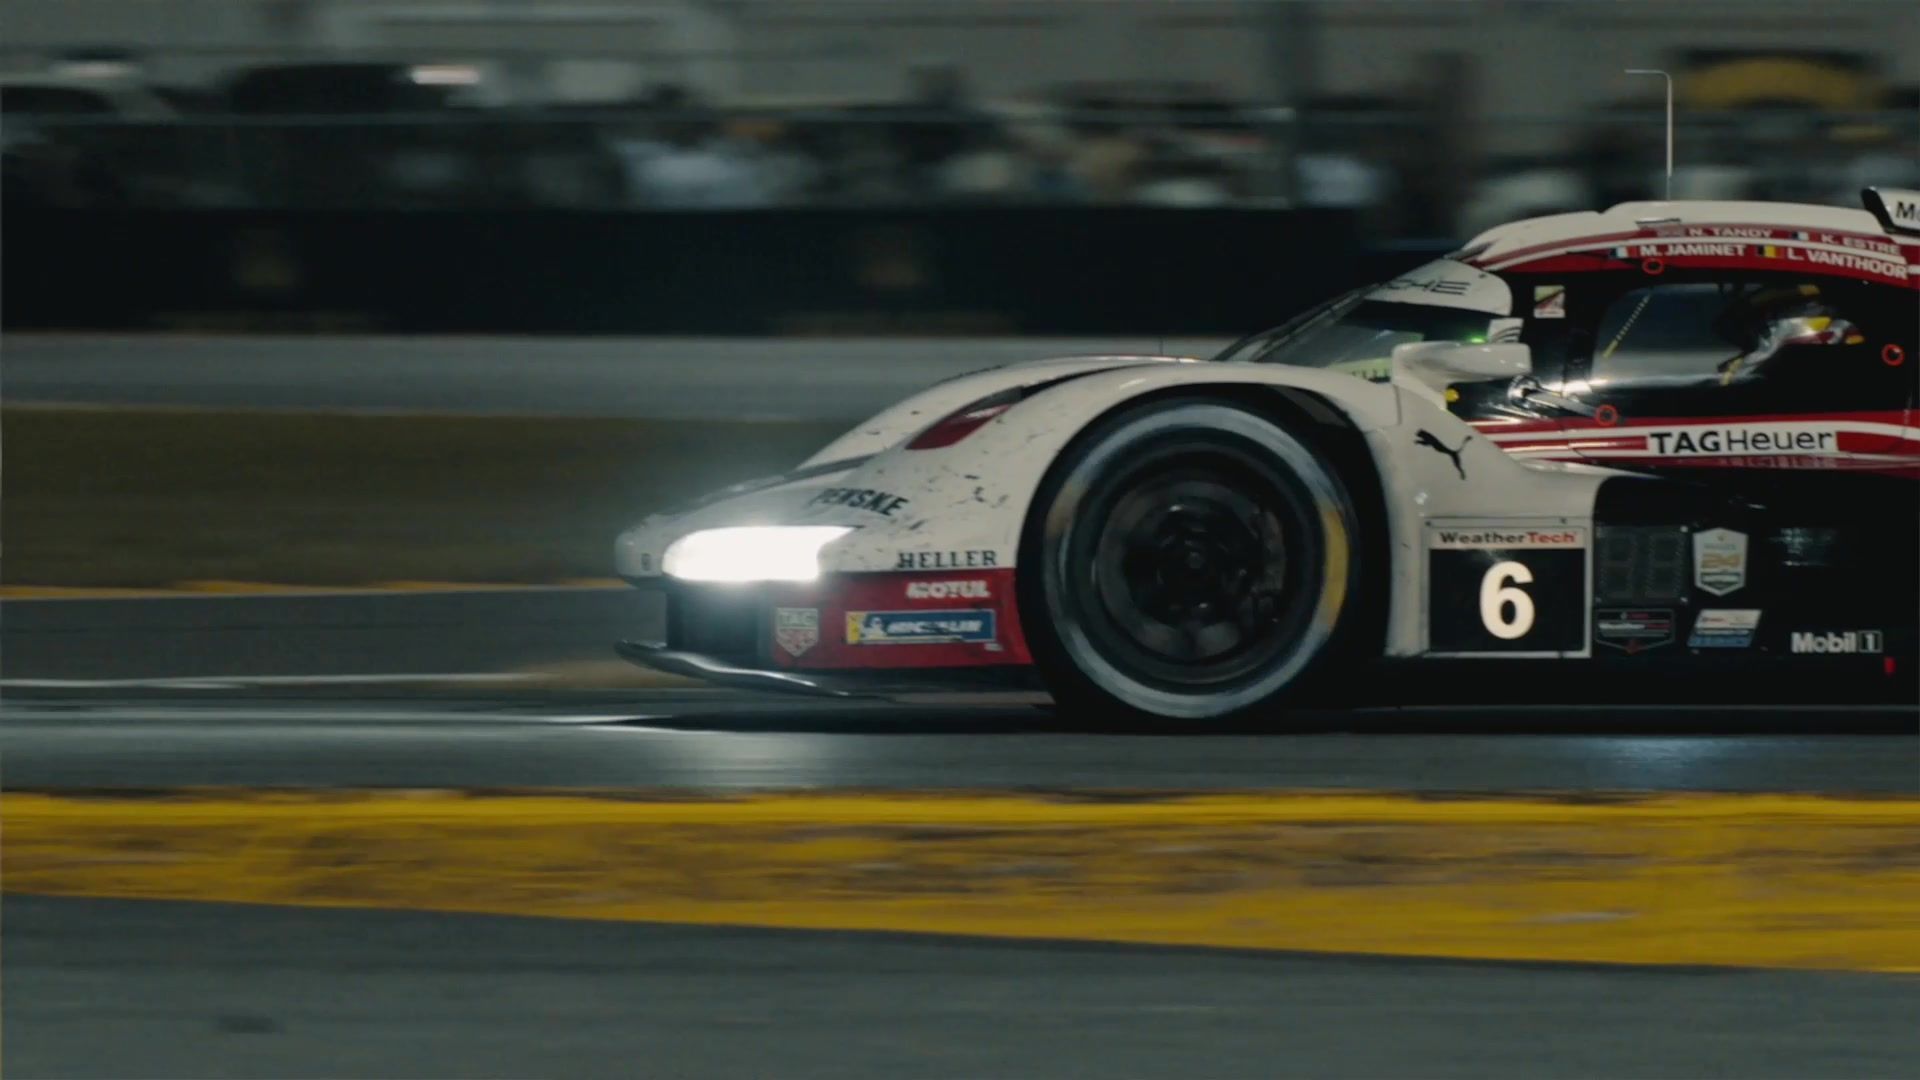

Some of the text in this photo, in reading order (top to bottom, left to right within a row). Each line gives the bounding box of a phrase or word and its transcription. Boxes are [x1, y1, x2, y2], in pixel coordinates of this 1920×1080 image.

[1667, 243, 1746, 256] JAMINET
[1843, 237, 1901, 256] ESTRE
[1806, 248, 1909, 280] VANTHOOR
[1440, 531, 1576, 544] WeatherTech
[897, 550, 997, 569] HELLER
[1480, 560, 1536, 640] 6
[1791, 631, 1857, 654] Mobil
